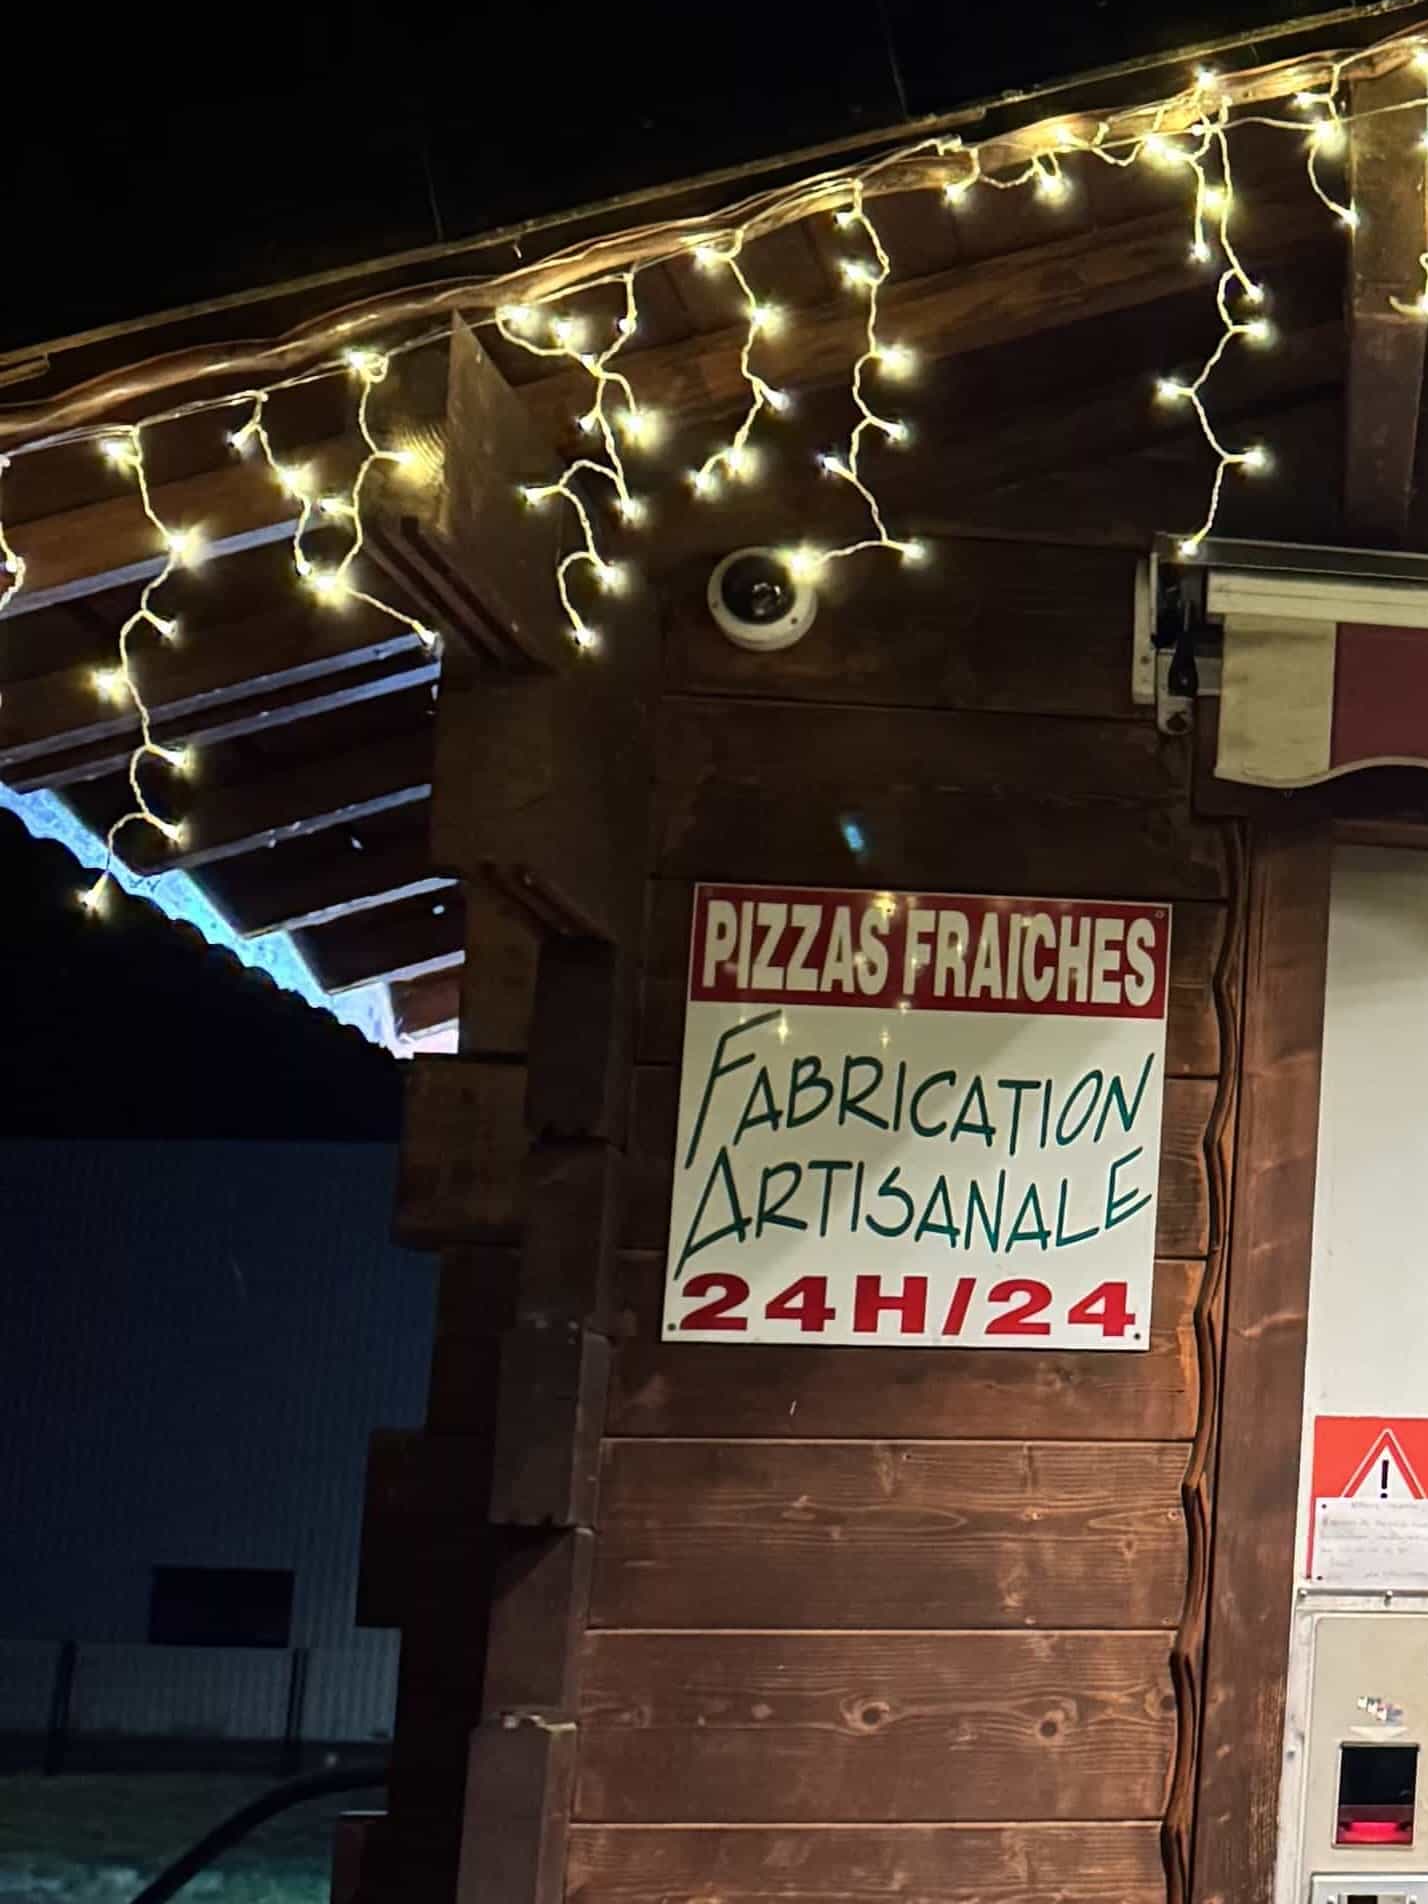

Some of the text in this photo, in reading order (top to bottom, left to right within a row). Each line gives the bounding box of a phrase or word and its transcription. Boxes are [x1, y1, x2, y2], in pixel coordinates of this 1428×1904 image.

[702, 900, 1155, 1007] PIZZAS FRAICHES
[685, 1010, 1155, 1169] FABRICATION
[674, 1146, 1152, 1281] ARTISANALE
[679, 1272, 1136, 1337] 24H/24
